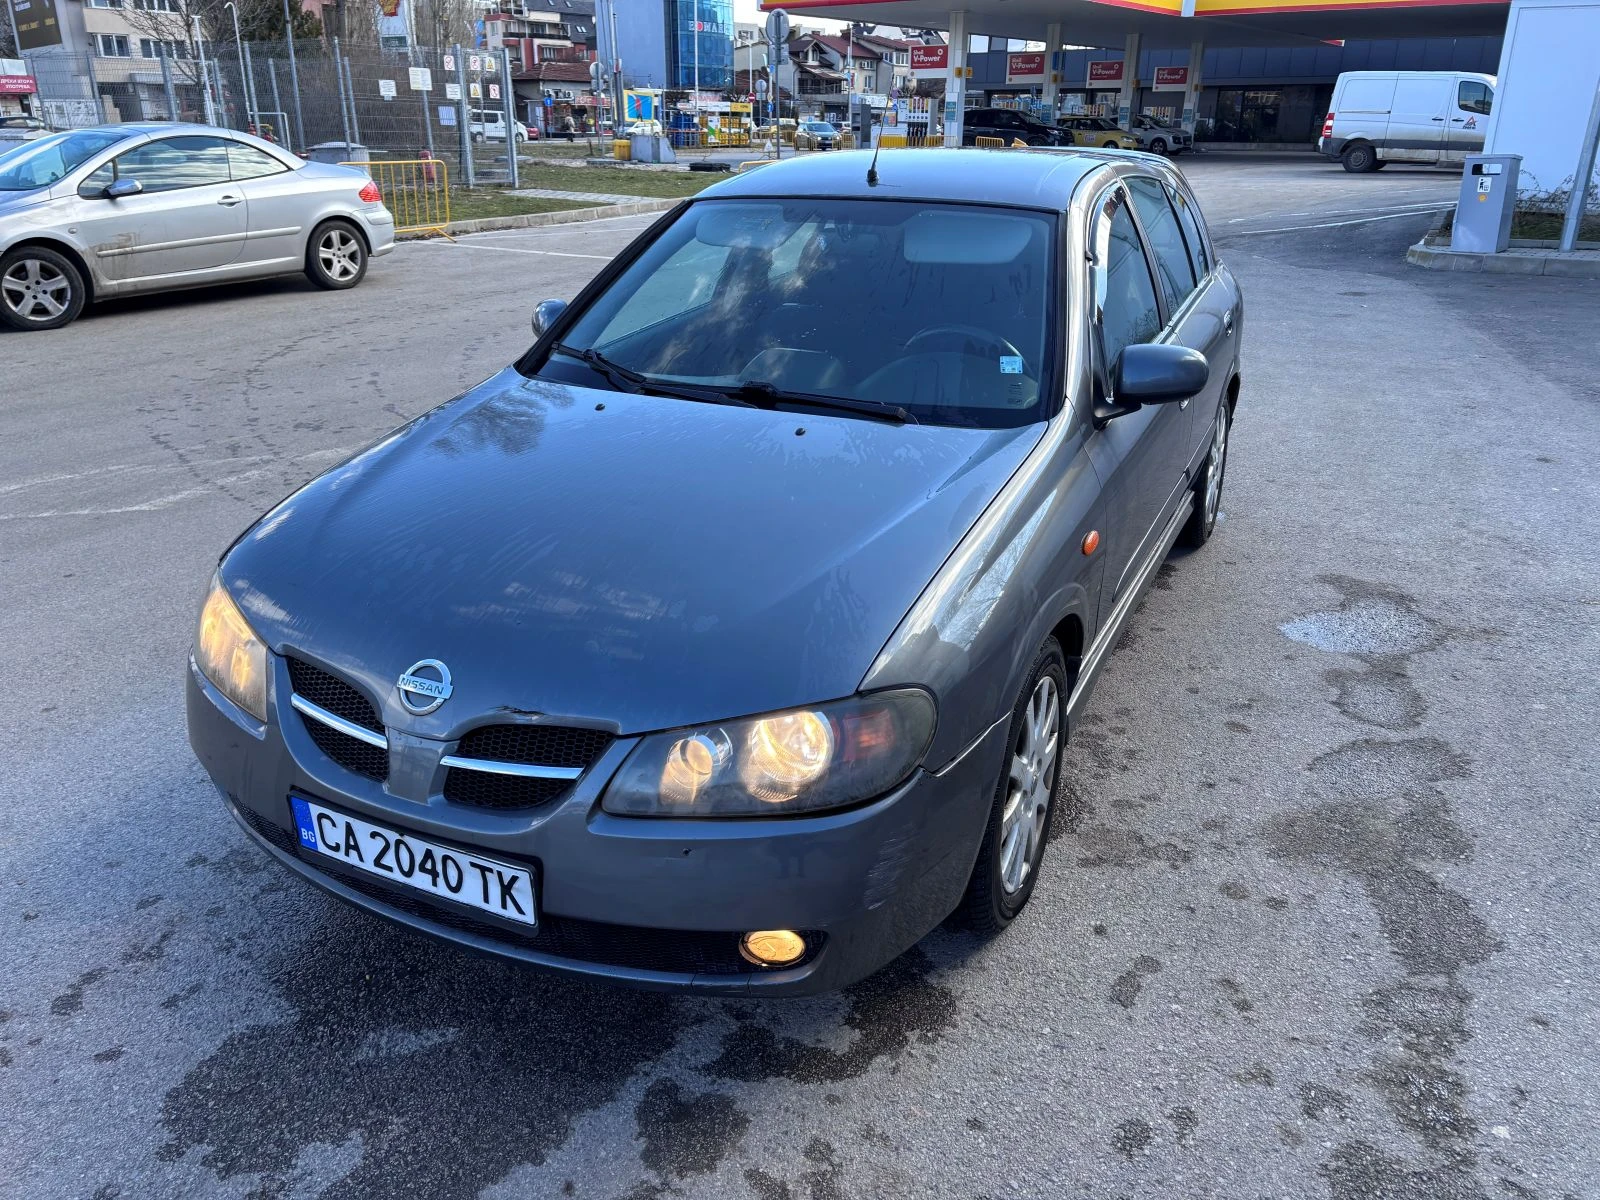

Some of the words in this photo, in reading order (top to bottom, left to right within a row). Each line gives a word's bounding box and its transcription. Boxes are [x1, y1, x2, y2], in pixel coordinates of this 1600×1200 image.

[400, 677, 445, 695] NISSAN
[301, 827, 316, 843] BG
[317, 812, 364, 863] CA
[370, 831, 463, 894] 2040
[470, 861, 527, 916] TK
